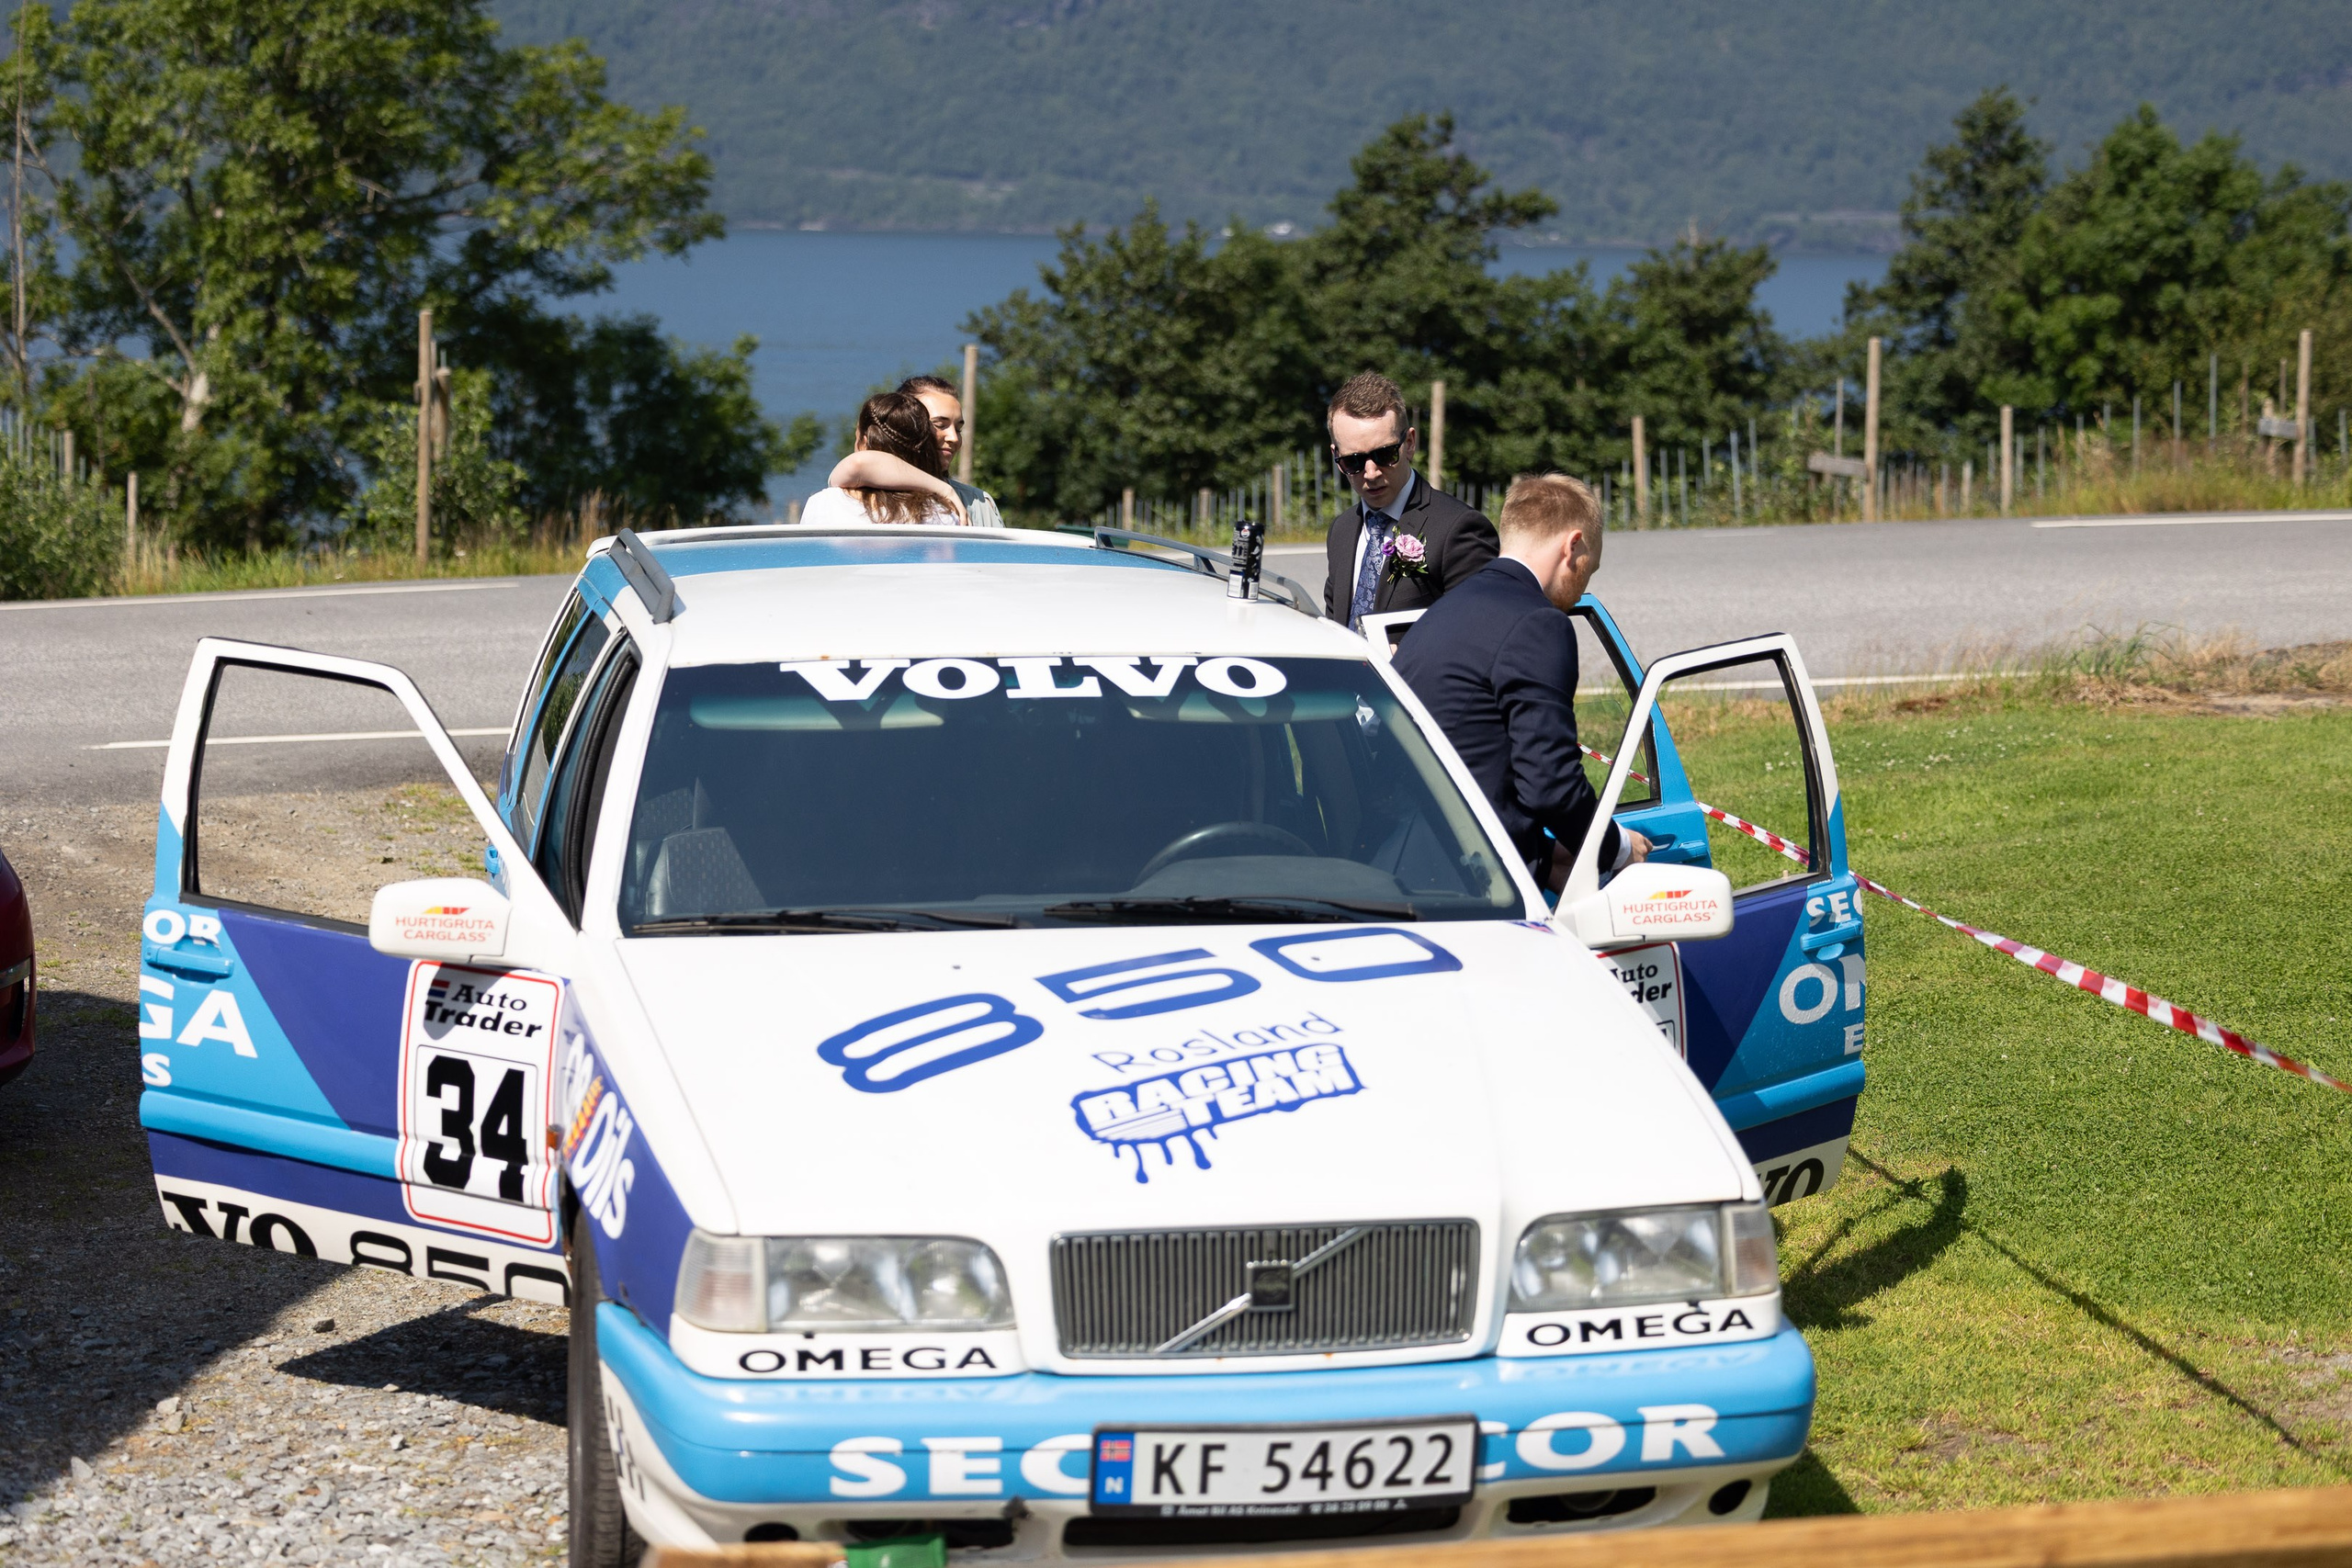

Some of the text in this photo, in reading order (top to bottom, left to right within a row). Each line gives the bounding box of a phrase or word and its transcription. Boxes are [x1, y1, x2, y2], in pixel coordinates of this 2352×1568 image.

[780, 657, 1287, 701] VOLVO
[395, 917, 495, 930] HURTIGRUTA
[1623, 899, 1718, 914] HURTIGRUTA
[451, 984, 527, 1011] Auto
[817, 927, 1463, 1094] 850
[424, 1000, 543, 1038] Trader
[1090, 1012, 1344, 1075] Rosland
[1079, 1043, 1345, 1132] RACING
[1167, 1063, 1355, 1128] TEAM
[423, 1055, 529, 1203] 34
[1527, 1308, 1755, 1347] OMEGA
[739, 1346, 997, 1373] OMEGA
[1150, 1432, 1454, 1495] KF 54622
[1104, 1476, 1124, 1495] N
